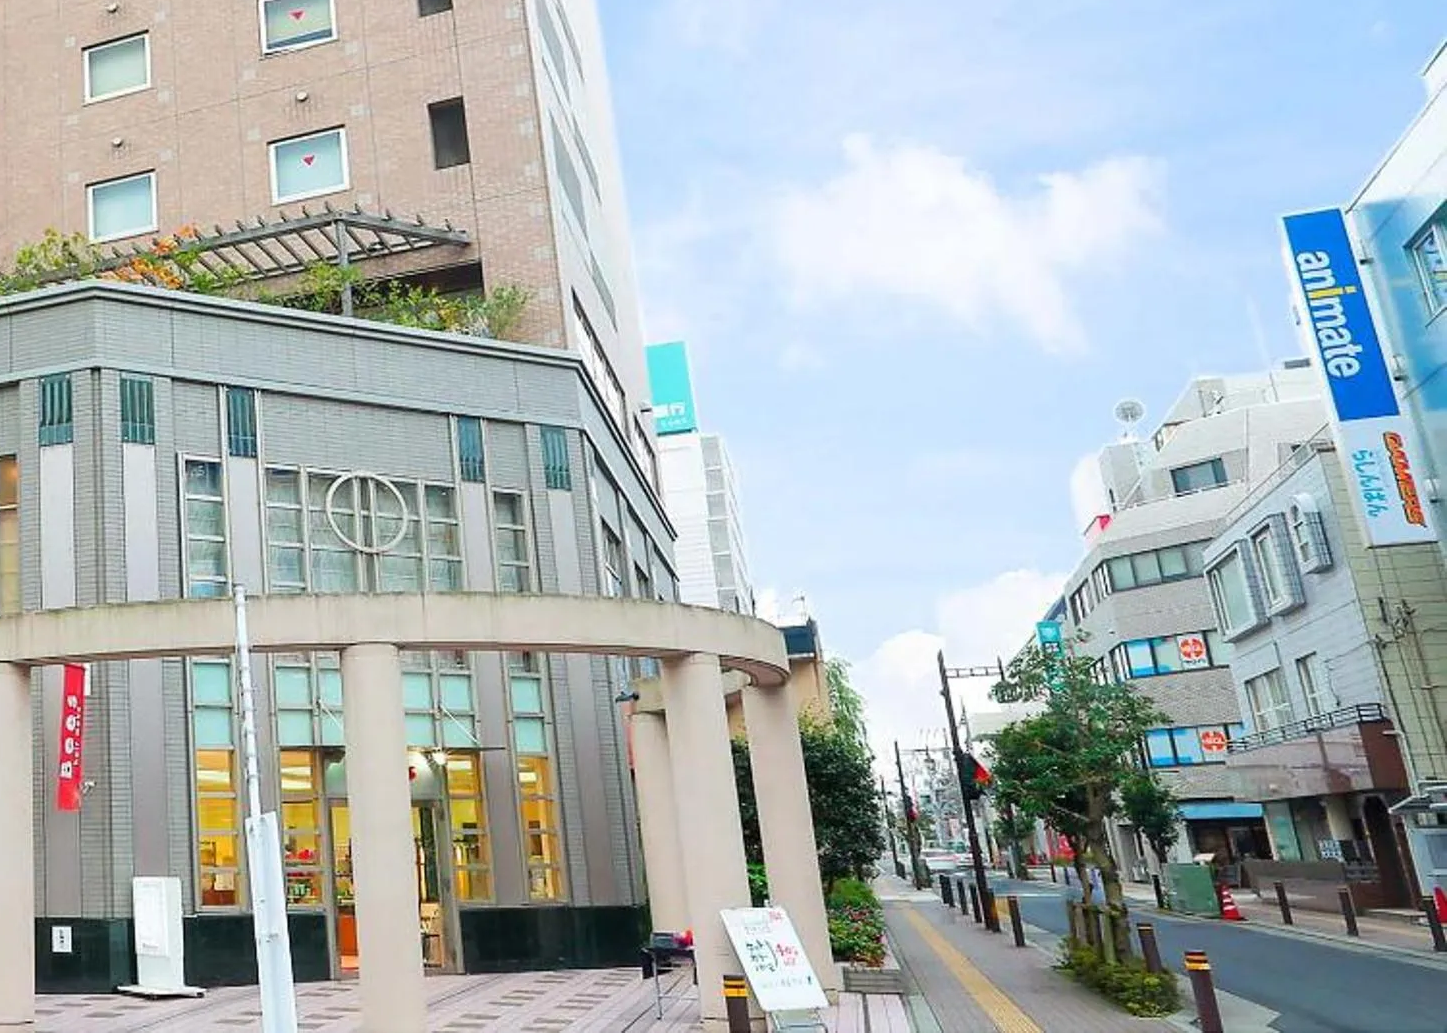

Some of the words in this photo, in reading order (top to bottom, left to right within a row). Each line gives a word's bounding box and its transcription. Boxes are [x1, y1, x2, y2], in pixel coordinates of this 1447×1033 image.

[1296, 251, 1363, 378] animate
[1352, 450, 1388, 518] らしんばん
